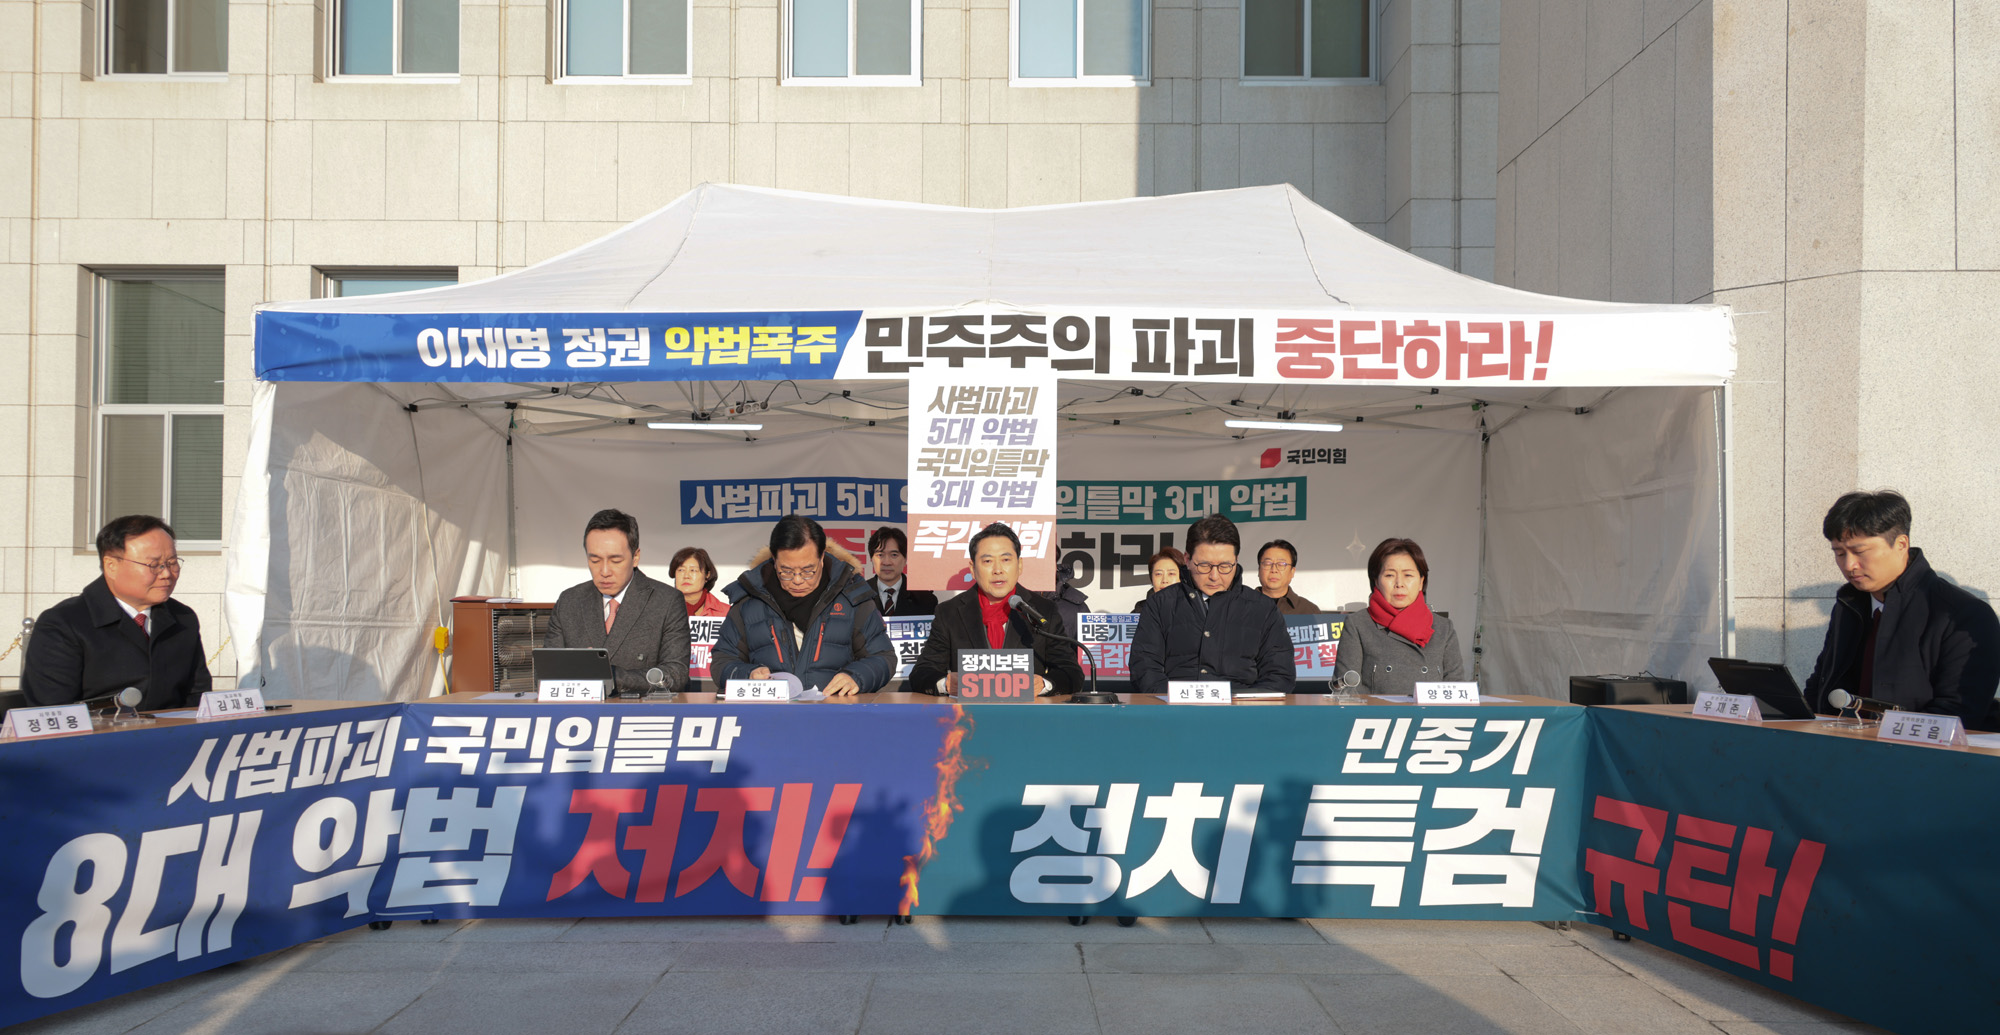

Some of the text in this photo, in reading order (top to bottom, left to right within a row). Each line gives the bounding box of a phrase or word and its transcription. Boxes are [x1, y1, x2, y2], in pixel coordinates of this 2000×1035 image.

[416, 315, 1554, 380] 이재명 정권 악법폭주 민주주의 파괴 중단하라!
[927, 386, 1039, 415] 사법파괴
[927, 418, 1038, 446] 5대 악법
[916, 448, 1050, 478] 국민입틀막
[1287, 448, 1347, 464] 국민의힘
[690, 482, 826, 519] 사법파괴
[836, 482, 891, 518] 5대
[927, 480, 975, 508] 3대
[981, 481, 1038, 508] 악법
[1165, 485, 1220, 519] 3대
[1230, 482, 1297, 518] 악법
[1082, 625, 1122, 641] 민중기
[962, 654, 1029, 671] 정치보복
[550, 687, 590, 697] 김민수
[737, 687, 776, 697] 송언석
[962, 673, 1030, 697] STOP
[27, 715, 78, 733] 정희용
[1341, 718, 1545, 775] 민중기
[167, 716, 742, 806] 사법파괴·국민입틀막
[20, 783, 863, 999] 8대 악법 저지!
[1009, 782, 1826, 982] 정치 특검 규탄!
